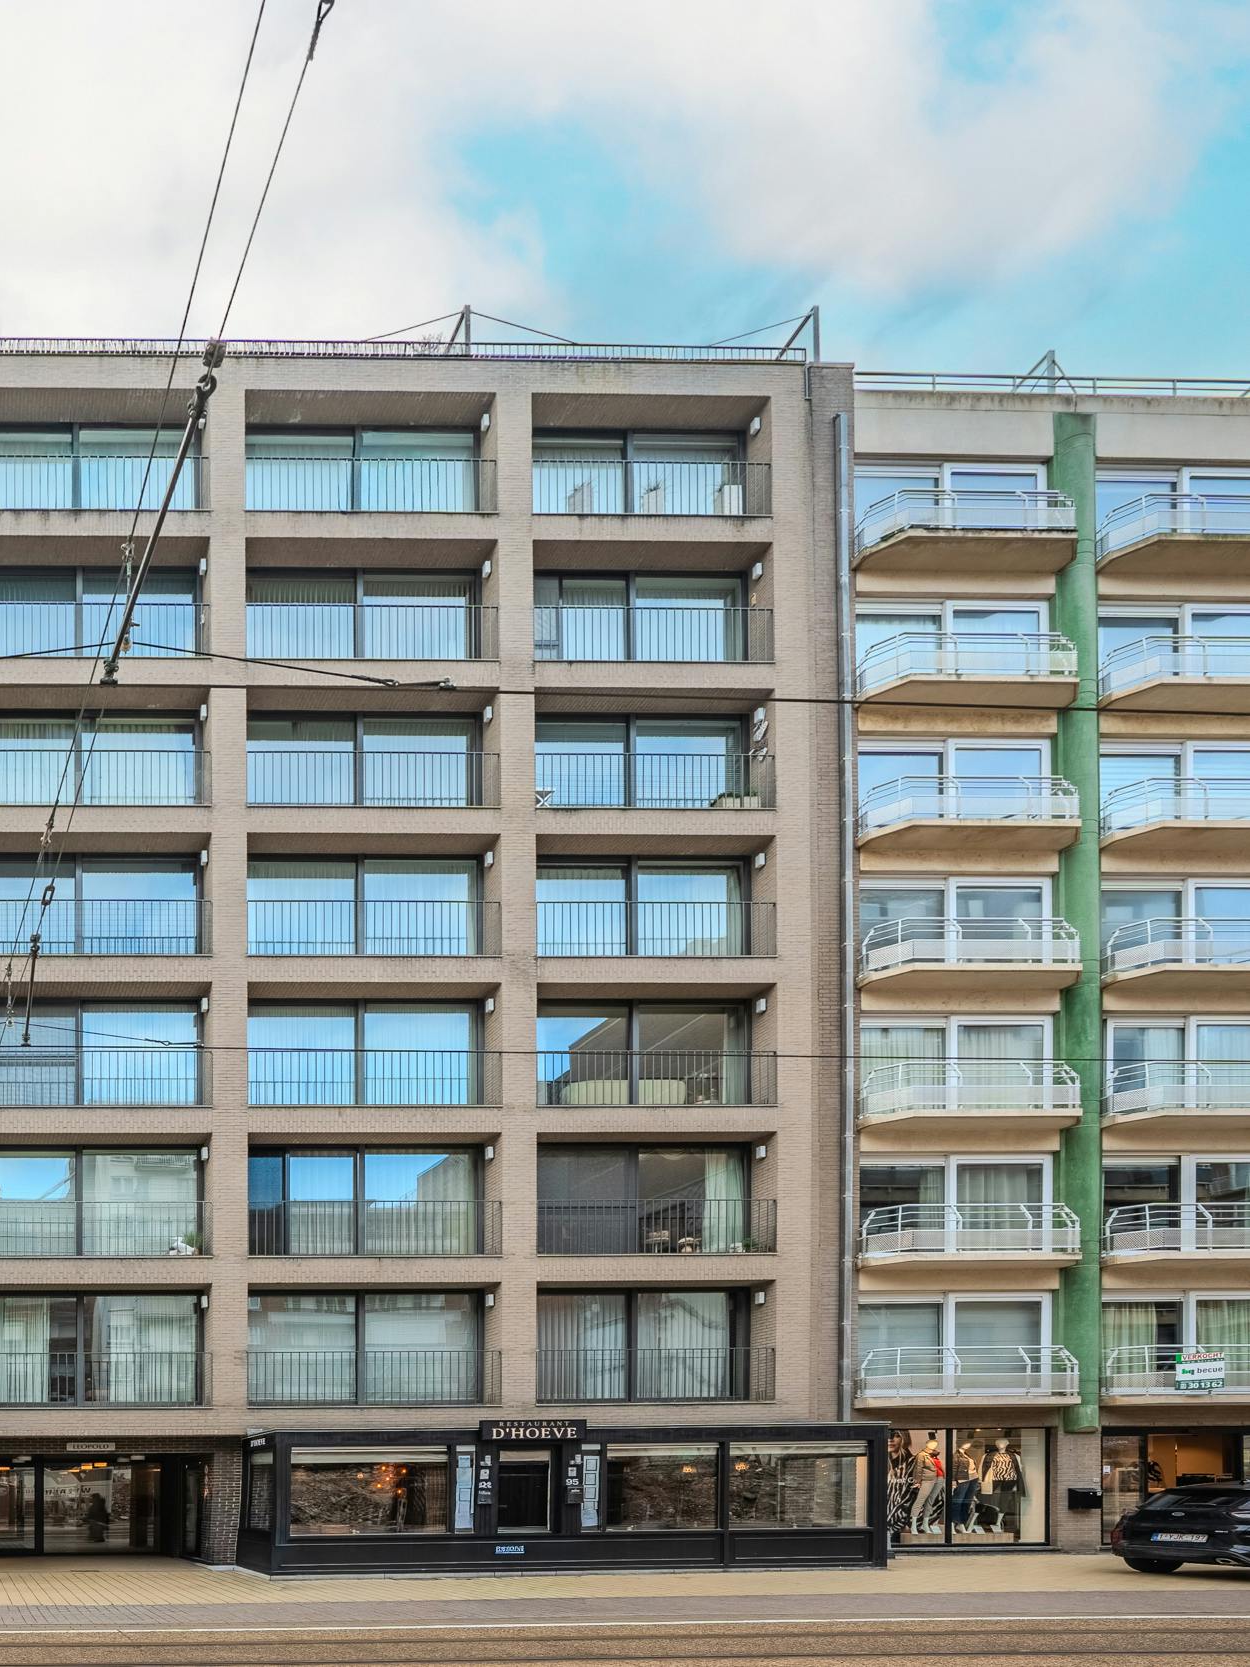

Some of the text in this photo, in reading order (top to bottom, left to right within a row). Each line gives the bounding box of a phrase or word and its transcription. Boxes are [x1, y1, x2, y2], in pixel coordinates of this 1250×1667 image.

[1182, 1352, 1223, 1360] VERKOCHT
[1197, 1366, 1223, 1374] becue
[491, 1427, 578, 1440] D'HOEVE
[565, 1478, 580, 1486] 95
